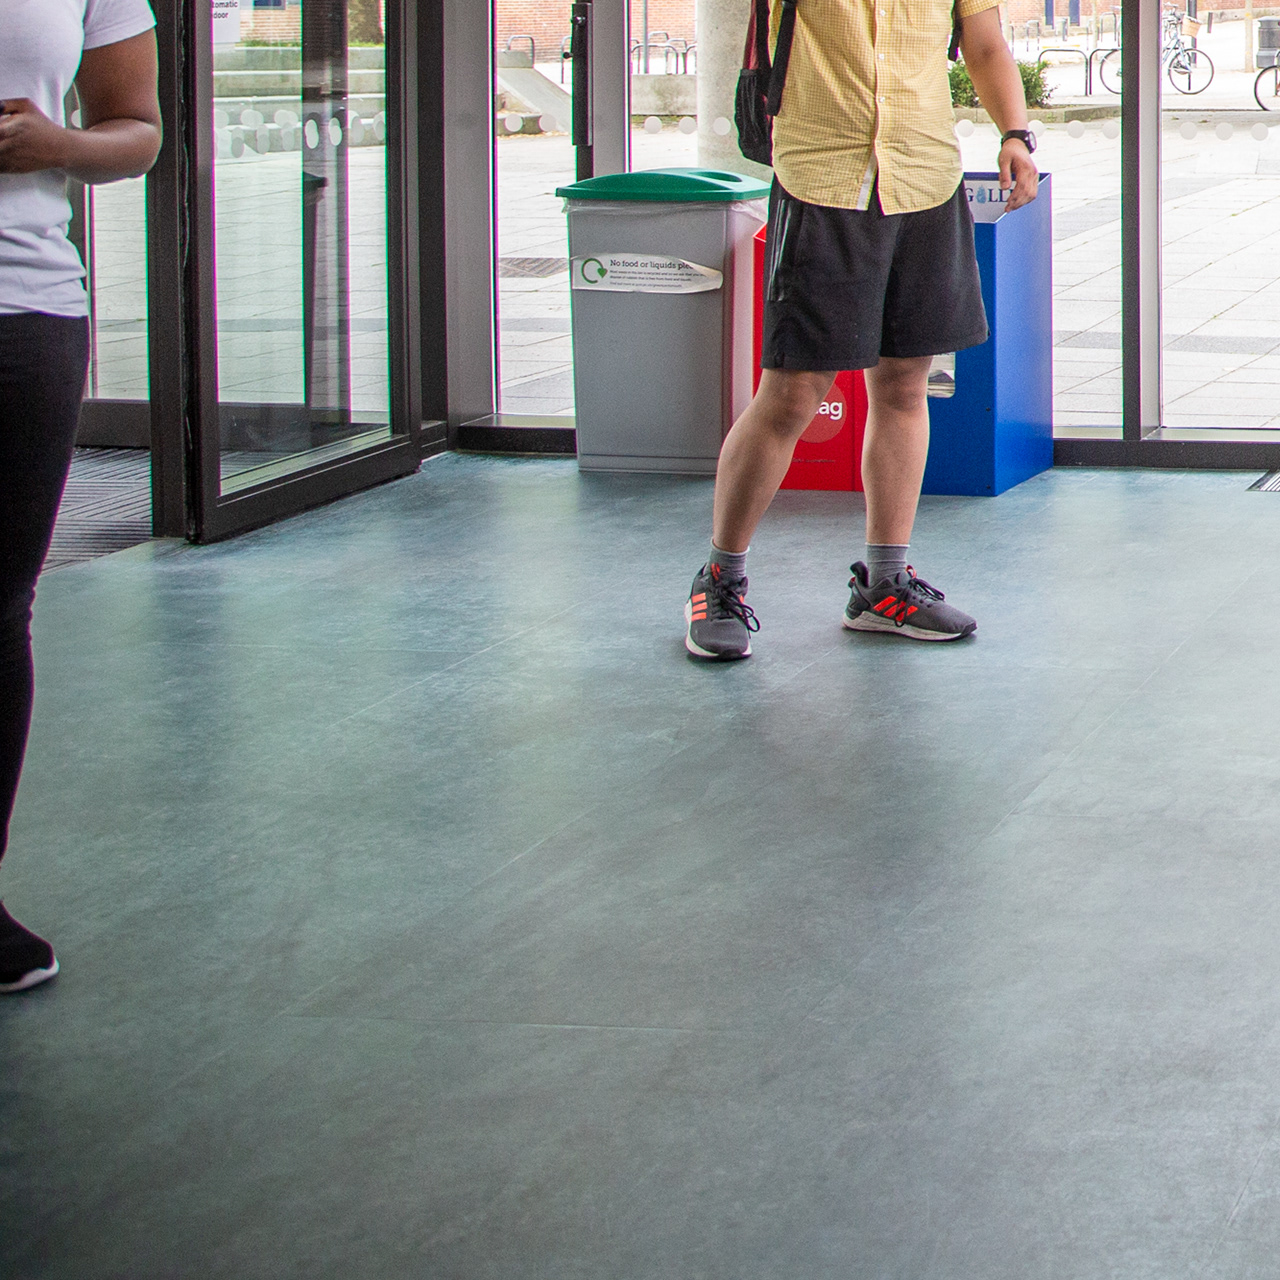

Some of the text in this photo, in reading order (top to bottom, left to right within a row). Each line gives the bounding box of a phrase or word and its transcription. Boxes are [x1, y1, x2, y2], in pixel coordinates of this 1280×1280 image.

[610, 259, 621, 267] No
[622, 260, 639, 268] food
[650, 261, 676, 269] liquids
